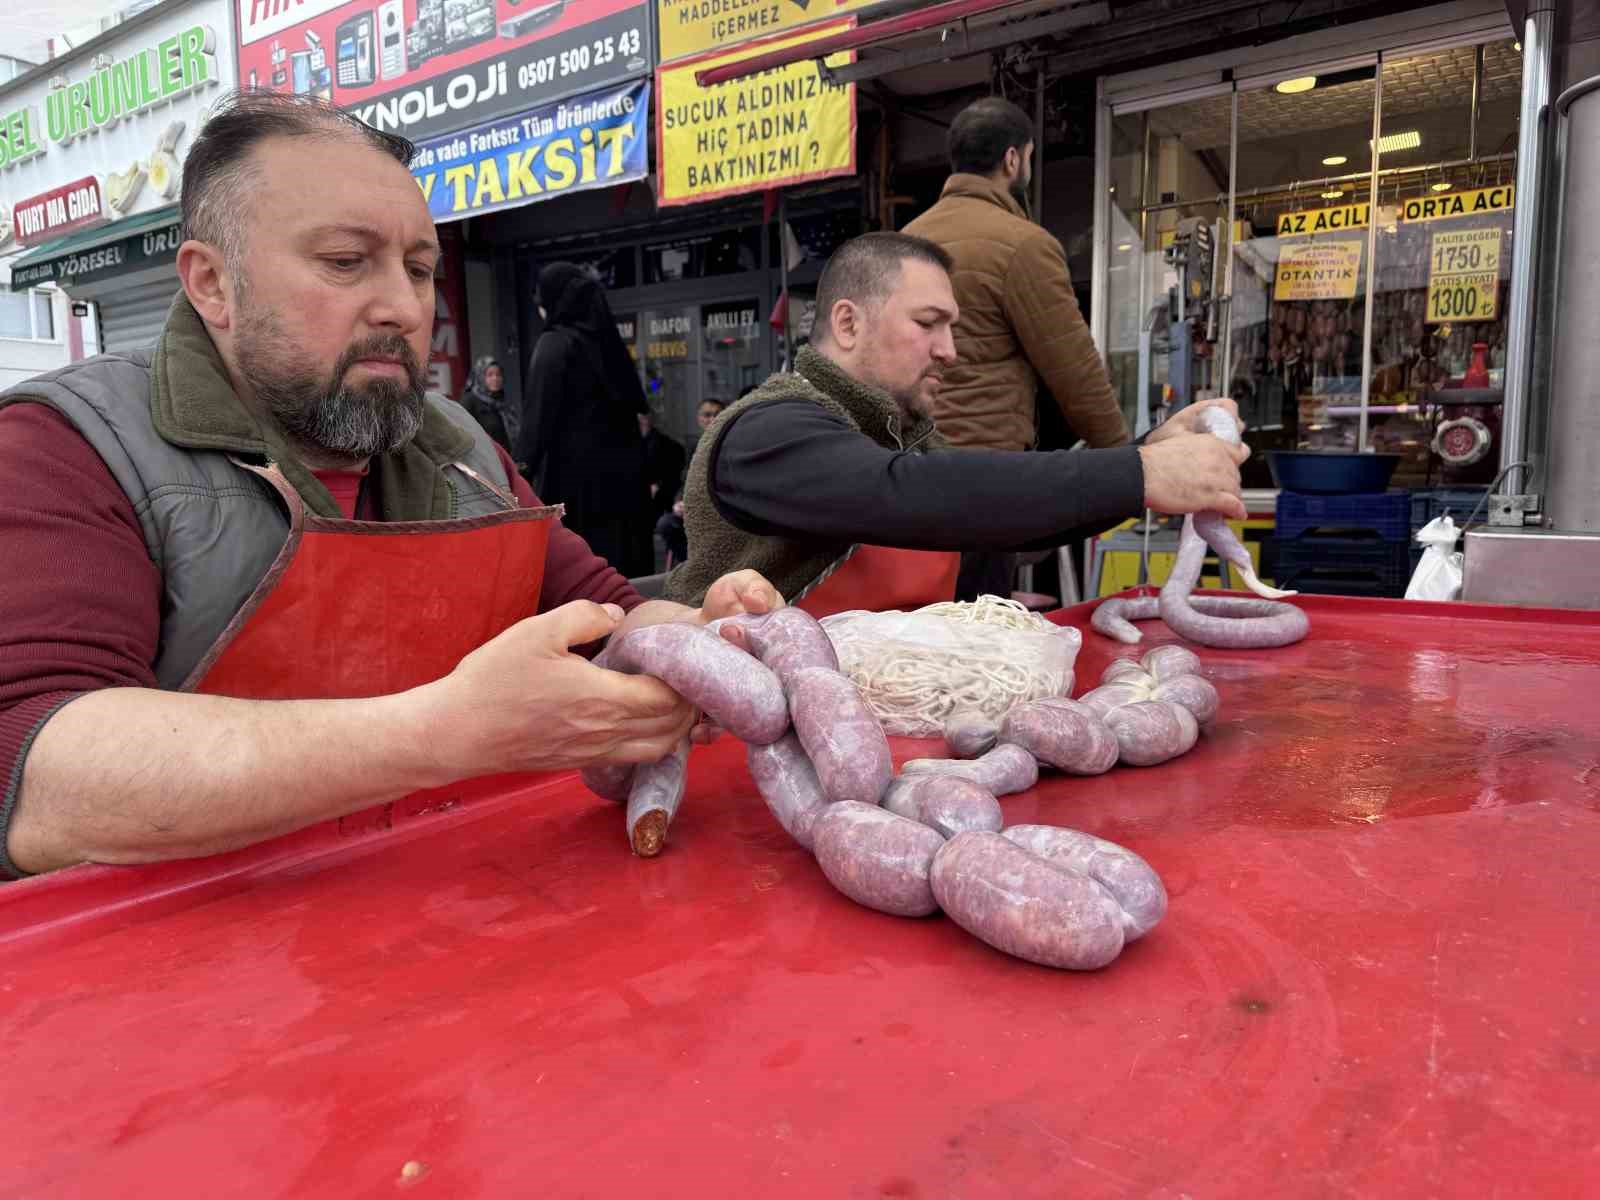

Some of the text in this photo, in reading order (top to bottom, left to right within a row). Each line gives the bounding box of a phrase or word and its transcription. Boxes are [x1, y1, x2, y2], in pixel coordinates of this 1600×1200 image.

[518, 55, 556, 89] 0507
[560, 46, 590, 76] 500
[593, 36, 615, 65] 25
[618, 28, 641, 56] 43
[665, 96, 728, 129] SUCUK
[737, 110, 808, 143] TADINA
[437, 143, 467, 164] vade
[470, 126, 520, 155] Farksız
[522, 115, 553, 141] Tüm
[557, 95, 634, 131] Ürünlerde
[688, 145, 800, 188] BAKTINIZMI
[16, 206, 46, 237] YURT
[68, 185, 99, 219] GIDA
[1406, 196, 1464, 220] ORTA
[1279, 216, 1306, 235] AZ
[1434, 244, 1481, 272] 1750
[1431, 286, 1477, 318] 1300
